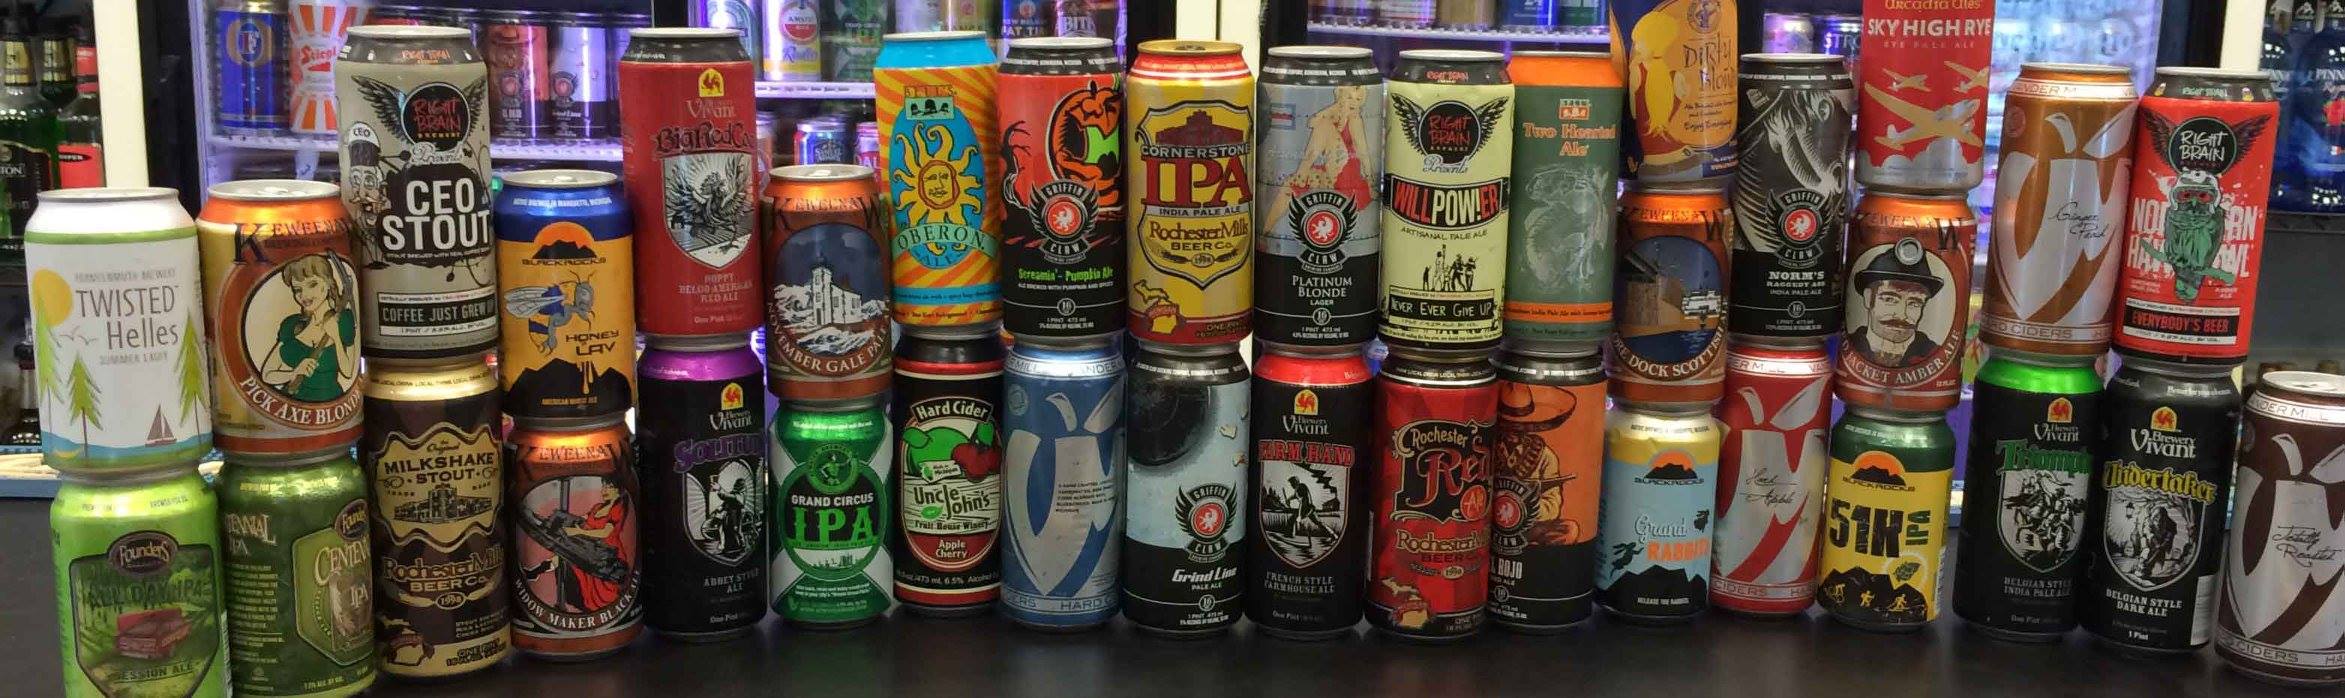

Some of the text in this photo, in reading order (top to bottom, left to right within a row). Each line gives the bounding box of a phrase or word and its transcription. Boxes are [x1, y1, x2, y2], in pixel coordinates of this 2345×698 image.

[1868, 18, 1992, 36] SKY HIGH RYE
[411, 97, 461, 115] RIGHT
[413, 112, 462, 132] BRAIN
[1428, 113, 1470, 130] RIGHT
[352, 128, 370, 138] CEO
[1428, 129, 1471, 148] BRAIN
[1523, 123, 1556, 140] Two
[2180, 130, 2228, 148] RIGHT
[1560, 141, 1590, 158] Ale
[2178, 145, 2226, 162] BRAIN
[1045, 181, 1086, 197] GRIFFIN
[1141, 157, 1254, 208] IPA
[406, 178, 475, 216] CEO
[1304, 192, 1344, 206] GRIFFIN
[1785, 192, 1821, 207] GRIFFIN
[1159, 205, 1242, 217] INDIA PALE ALE
[381, 209, 491, 253] STOUT
[897, 223, 985, 252] OBERON
[1401, 226, 1489, 241] ARTISANAL PALE ALE
[1050, 241, 1082, 254] CLAW
[1171, 241, 1214, 252] BEER
[1786, 249, 1813, 260] CLAW
[521, 257, 608, 267] BLACKROCKS
[1307, 253, 1340, 265] CLAW
[1292, 274, 1353, 288] PLATINUM
[1768, 270, 1825, 282] NORM'S
[1297, 286, 1348, 299] BLONDE
[76, 286, 177, 318] TWISTED
[1310, 299, 1335, 307] LAGER
[1391, 299, 1413, 313] NEVER
[1420, 301, 1446, 317] EVER
[1480, 301, 1494, 316] UP
[382, 300, 487, 325] COFFEE JUST GREW
[2132, 310, 2200, 330] EVERYBODY'S
[2203, 315, 2229, 331] BEER
[107, 319, 180, 351] Helles
[565, 329, 619, 344] HONEY
[2009, 322, 2072, 338] CIDERS
[826, 350, 867, 374] GALE
[1629, 353, 1670, 377] DOCK
[1895, 358, 1944, 384] AMBER
[240, 378, 313, 427] PICK AXE
[916, 400, 989, 420] Hard Cider
[1412, 426, 1469, 449] Rochester
[2033, 423, 2080, 443] Vivant
[2152, 432, 2196, 446] Brewery
[2130, 430, 2197, 459] Vivant
[384, 450, 495, 476] MILKSHAKE
[416, 467, 476, 486] STOUT
[2103, 459, 2218, 504] Undertaker
[791, 492, 874, 507] GRAND CIRCUS
[1192, 485, 1228, 501] GRIFFIN
[913, 483, 991, 521] Uncle John's
[793, 506, 881, 546] IPA
[915, 521, 934, 531] Fruit
[1905, 510, 1931, 546] IPA
[938, 540, 966, 554] Apple
[1194, 541, 1222, 553] CLAW
[936, 549, 967, 563] Cherry
[1172, 566, 1238, 583] Grind Line
[1498, 558, 1523, 580] ROJO
[410, 578, 464, 593] BEER
[1713, 580, 1769, 595] CIDERS
[513, 576, 548, 621] WIDOW
[549, 611, 596, 631] MAKER
[599, 592, 632, 627] BLACK
[1060, 597, 1102, 611] HARD
[2106, 589, 2183, 610] BELGIAN STYLE
[2116, 600, 2169, 617] DARK ALE
[2238, 640, 2299, 663] CIDERS
[172, 663, 194, 676] ALE
